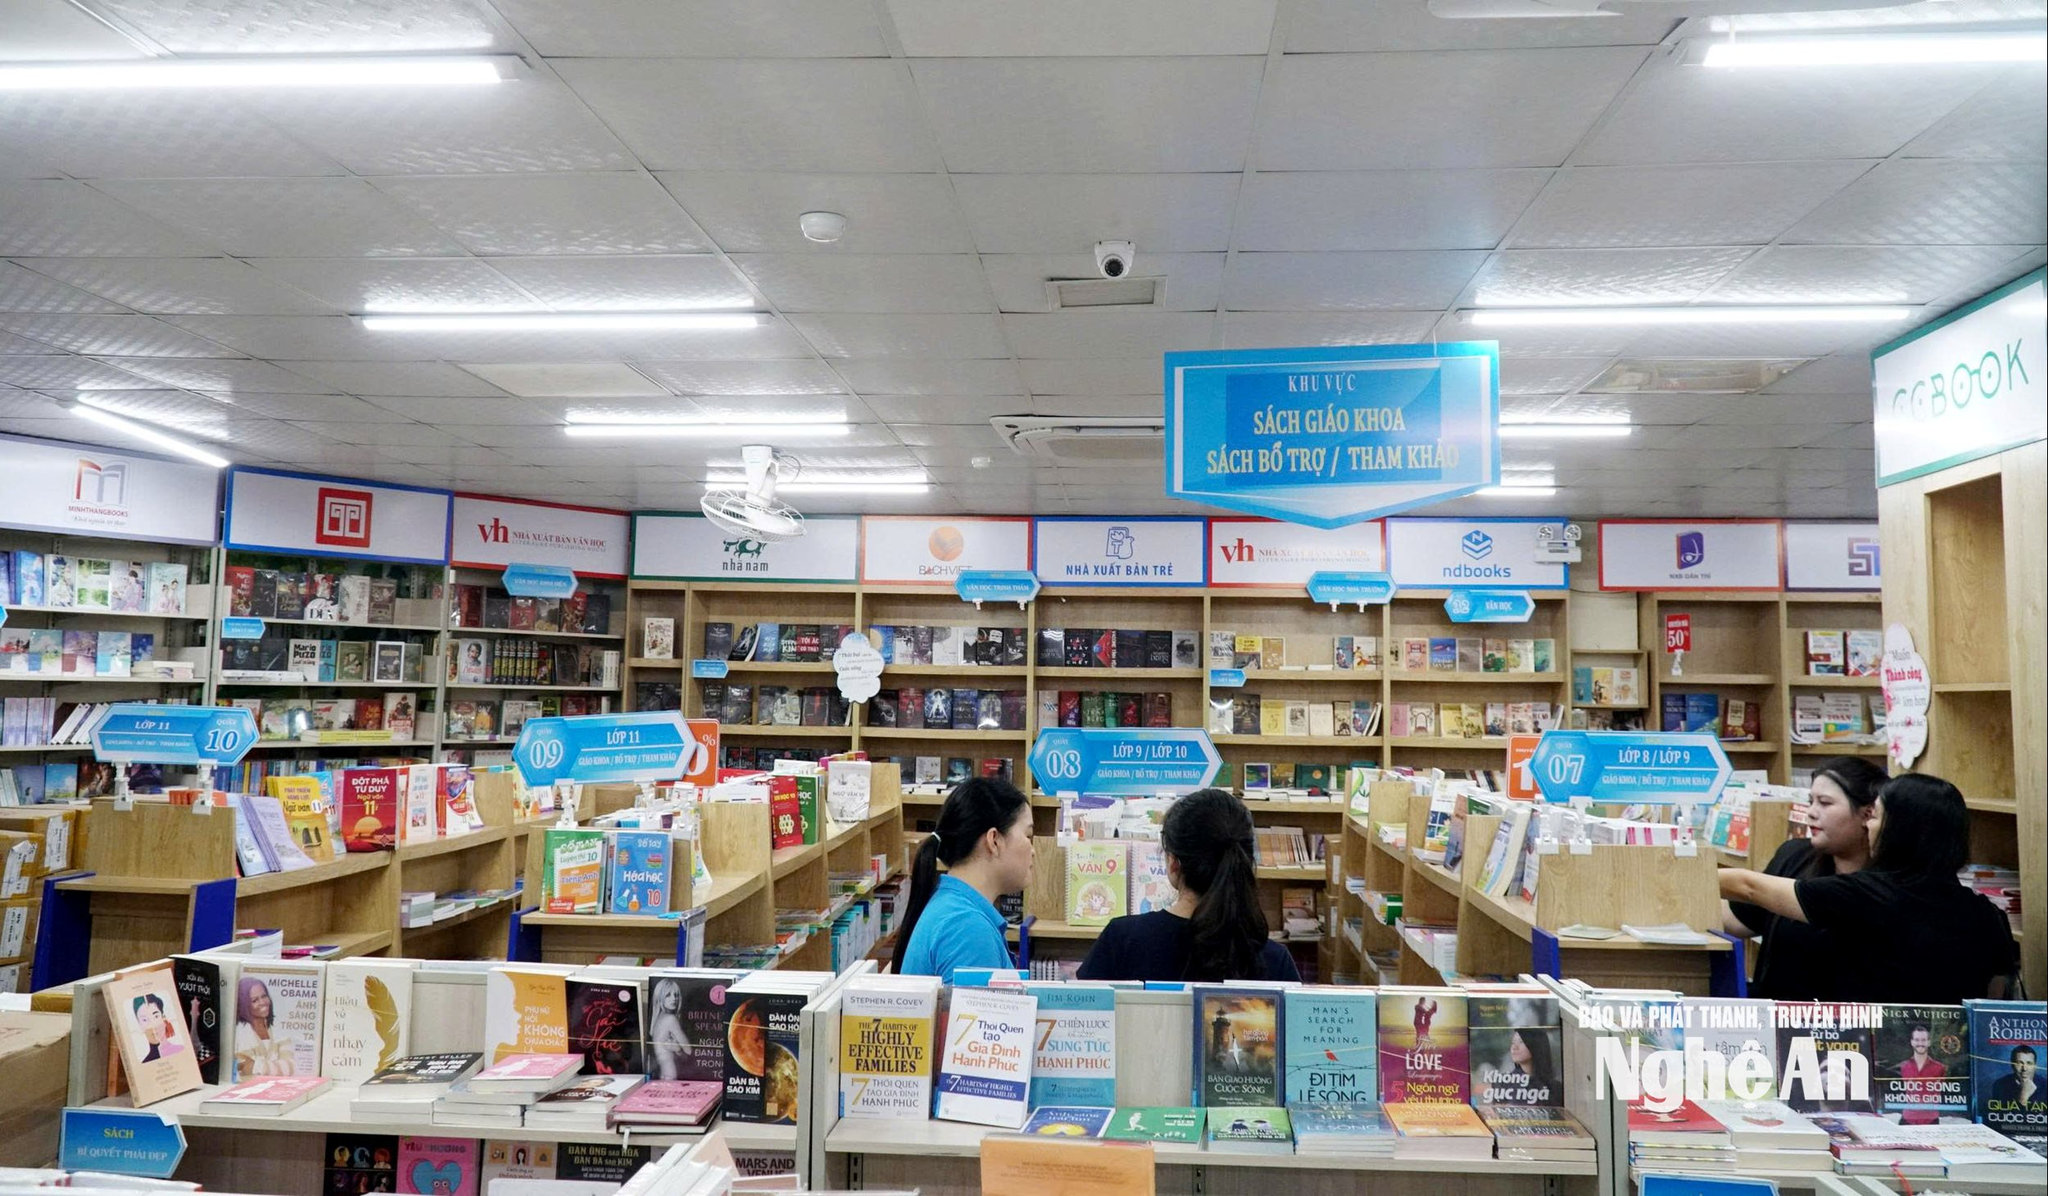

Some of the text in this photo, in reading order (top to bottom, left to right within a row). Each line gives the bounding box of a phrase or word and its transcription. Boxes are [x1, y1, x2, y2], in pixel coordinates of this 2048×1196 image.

[1288, 373, 1356, 395] KHU VỰC
[1253, 403, 1407, 435] SÁCH GIÁO KHOA
[1206, 444, 1253, 474] SÁCH
[1287, 448, 1326, 476] TRỢ
[1347, 446, 1402, 471] THAM
[1407, 438, 1460, 469] KHẢO
[68, 505, 128, 517] MINHTHANGBOOKS
[477, 517, 509, 544] vh
[512, 531, 531, 541] NHÀ
[532, 532, 554, 543] XUẤT
[555, 535, 571, 544] BẢN
[573, 536, 589, 546] VĂN
[1221, 538, 1254, 563] vh
[1066, 560, 1173, 576] NHÀ XUẤT BẢN TRẺ
[1443, 564, 1512, 578] ndbooks
[134, 719, 170, 731] LỚP 11
[206, 729, 241, 752] 10
[606, 728, 640, 745] LỚP 11
[530, 739, 563, 769] 09
[1113, 741, 1134, 758] LỚP
[1135, 745, 1142, 757] 9
[1151, 741, 1172, 758] LỚP
[1175, 745, 1187, 757] 10
[1618, 746, 1640, 763] LỚP
[1642, 750, 1650, 763] 8
[1659, 747, 1681, 763] LỚP
[1683, 750, 1691, 763] 9
[1046, 749, 1081, 778] 08
[1548, 754, 1585, 784] 07
[1097, 768, 1112, 778] GIÁO
[1113, 768, 1130, 778] KHOA
[1164, 769, 1182, 778] THAM
[352, 776, 390, 787] ĐỘT PHÁ
[355, 784, 387, 794] TƯ DUY
[1078, 859, 1117, 874] VĂN 9
[623, 869, 664, 884] Hóa học
[647, 889, 661, 906] 10
[269, 978, 318, 989] MICHELLE
[280, 989, 318, 999] OBAMA
[850, 996, 923, 1006] STEPHEN R. COVEY
[1047, 993, 1095, 1003] JIM ROHN
[296, 998, 317, 1010] ÁNH
[1312, 1006, 1350, 1015] MAN'S
[289, 1009, 316, 1021] SÁNG
[1308, 1016, 1354, 1025] SEARCH
[1913, 1009, 1960, 1019] VUJICIC
[281, 1021, 316, 1031] TRONG
[524, 1022, 565, 1037] KHÔNG
[768, 1022, 786, 1031] SAO
[859, 1018, 919, 1035] THE 7 HABITS OF
[954, 1013, 978, 1046] 7
[978, 1019, 1024, 1034] Thói Quen
[1057, 1016, 1084, 1029] CHIẾN
[303, 1032, 315, 1042] TA
[861, 1030, 915, 1046] HIGHLY
[1036, 1019, 1057, 1051] 7
[1320, 1026, 1342, 1035] FOR
[1048, 1039, 1111, 1053] SUNG TÚC
[1303, 1036, 1360, 1045] MEANING
[849, 1043, 923, 1060] EFFECTIVE
[968, 1041, 1021, 1058] Gia Đình
[856, 1058, 917, 1073] FAMILIES
[952, 1053, 1019, 1072] Hạnh Phúc
[1037, 1053, 1111, 1071] HẠNH PHÚC
[1405, 1053, 1442, 1071] LOVE
[729, 1076, 760, 1086] ĐÀN BÀ
[873, 1077, 919, 1089] THÓI QUEN
[949, 1075, 961, 1091] 7
[960, 1078, 982, 1087] HABITS
[989, 1082, 1014, 1092] HIGHLY
[1207, 1074, 1272, 1085] BẢN GIAO HƯỞNG
[1309, 1069, 1356, 1087] ĐI TÌM
[1483, 1069, 1530, 1086] Không
[727, 1086, 761, 1095] SAO KIM
[851, 1077, 870, 1106] 7
[884, 1089, 898, 1097] GIA
[899, 1087, 919, 1097] ĐÌNH
[957, 1085, 1016, 1099] EFFECTIVE FAMILIES
[1214, 1082, 1265, 1095] CUỘC SỐNG
[1406, 1080, 1460, 1097] Ngôn ngữ
[1483, 1084, 1550, 1104] gục ngã
[1890, 1080, 1960, 1093] CUỘC SỐNG
[862, 1097, 919, 1108] HẠNH PHÚC
[1884, 1093, 1967, 1106] KHÔNG GIỚI HẠN
[104, 1127, 134, 1140] SÁCH
[77, 1146, 168, 1163] BÍ QUYẾT PHÁI ĐẸP
[735, 1157, 796, 1169] MARS AND
